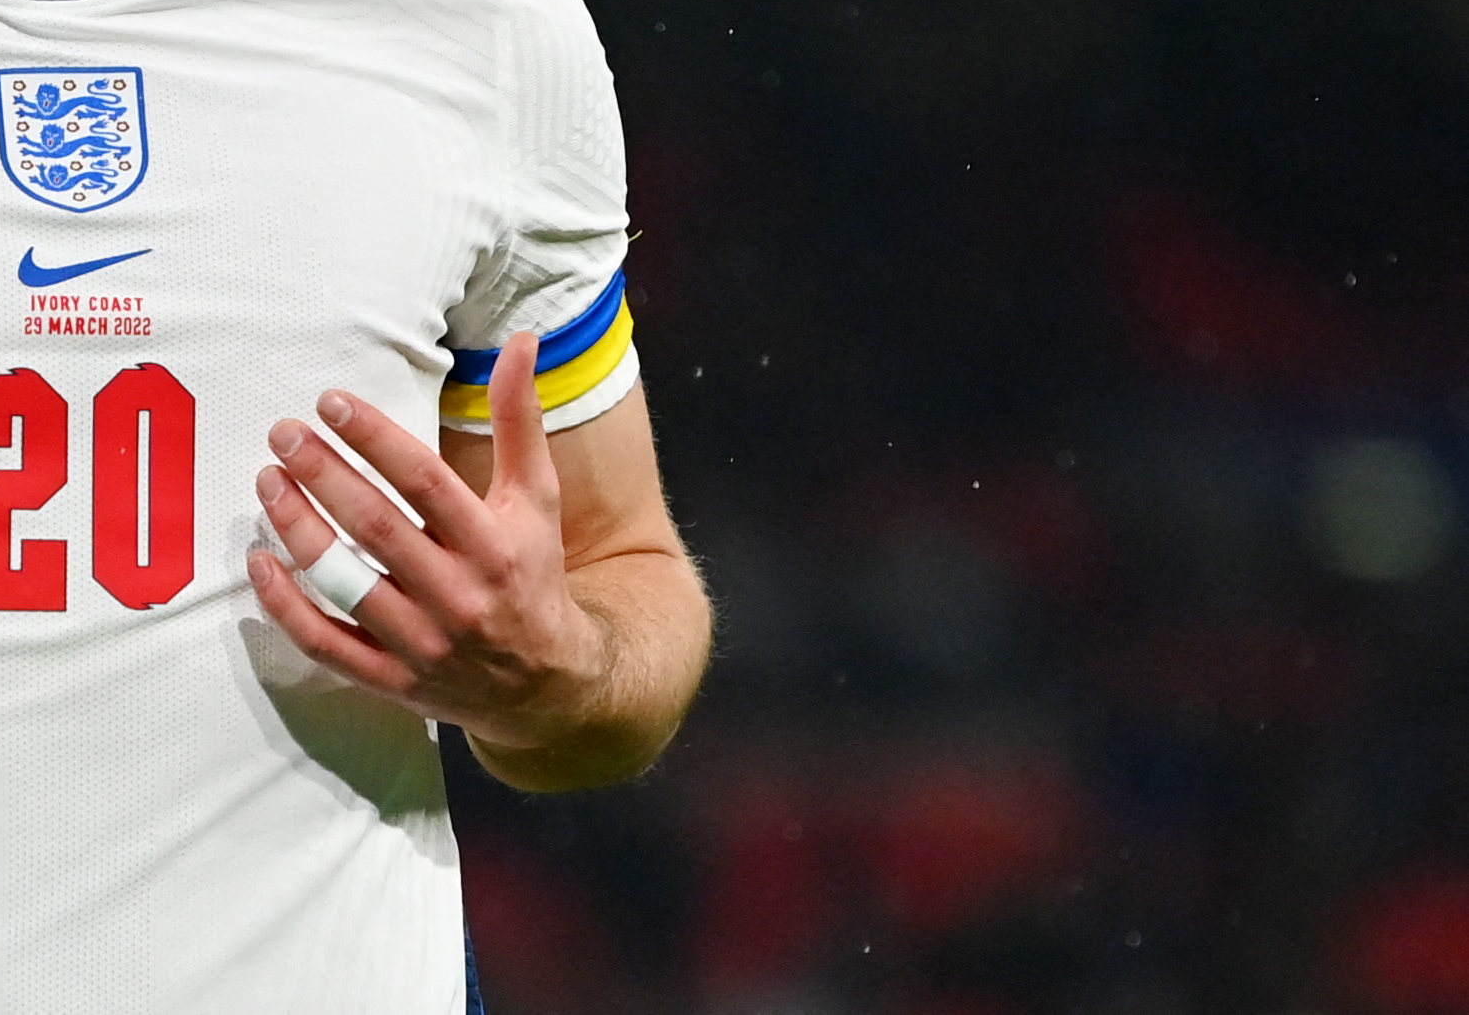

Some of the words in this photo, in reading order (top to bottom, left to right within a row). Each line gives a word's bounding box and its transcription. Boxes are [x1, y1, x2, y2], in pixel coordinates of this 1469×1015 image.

[30, 294, 80, 312] IVORY
[88, 295, 144, 313] COAST
[24, 316, 43, 335] 29
[48, 316, 109, 335] MARCH
[114, 316, 152, 337] 2022
